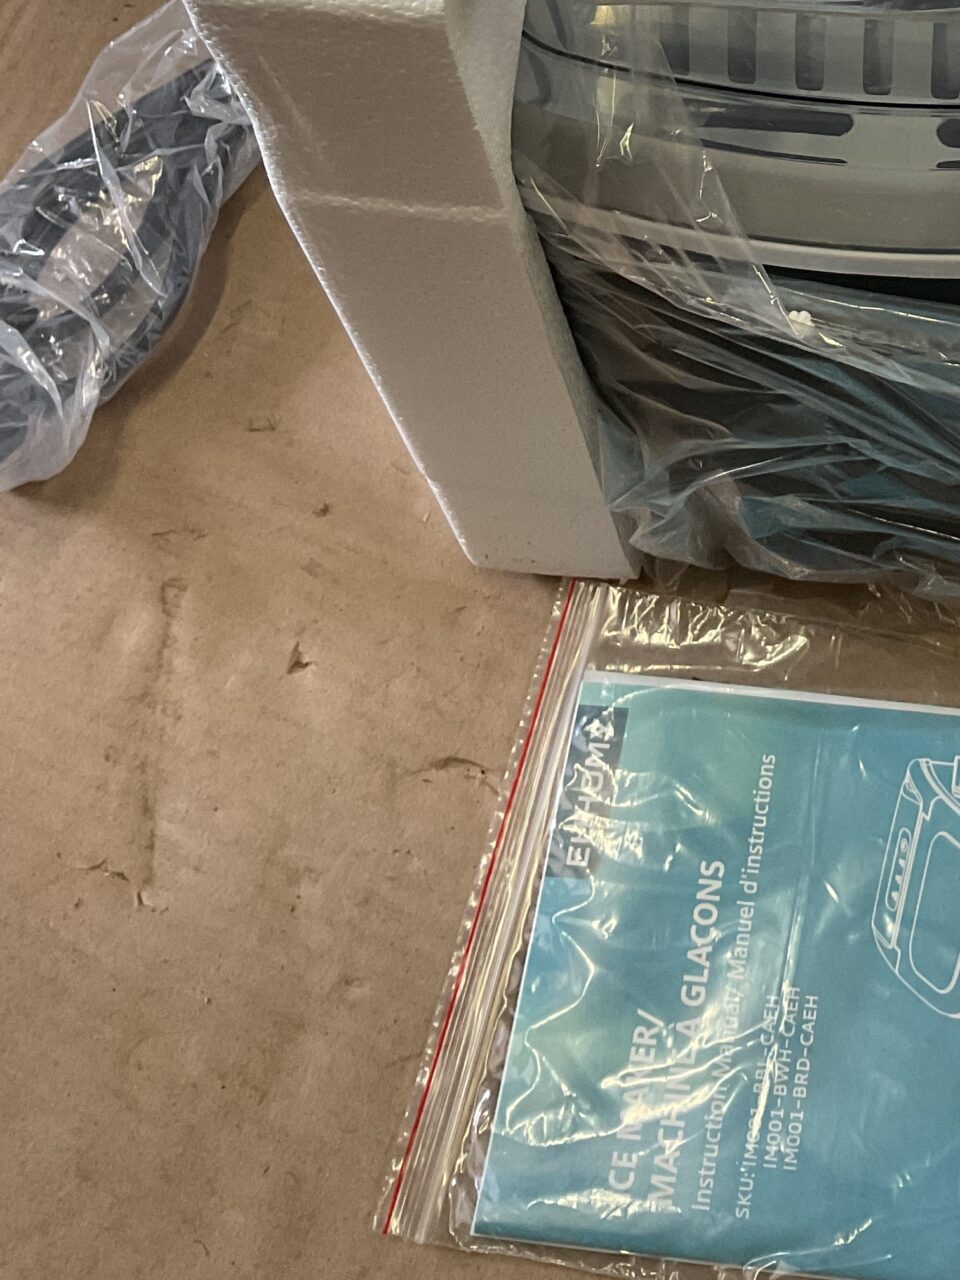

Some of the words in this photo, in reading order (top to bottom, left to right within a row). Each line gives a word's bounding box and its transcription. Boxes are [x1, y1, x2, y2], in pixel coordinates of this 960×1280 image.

[738, 753, 778, 895] d'instructions
[679, 859, 726, 1007] GLAÇONS
[728, 900, 756, 981] Manuel
[783, 995, 819, 1172] IM001-BRD-CAEH
[690, 1107, 731, 1213] Instruction
